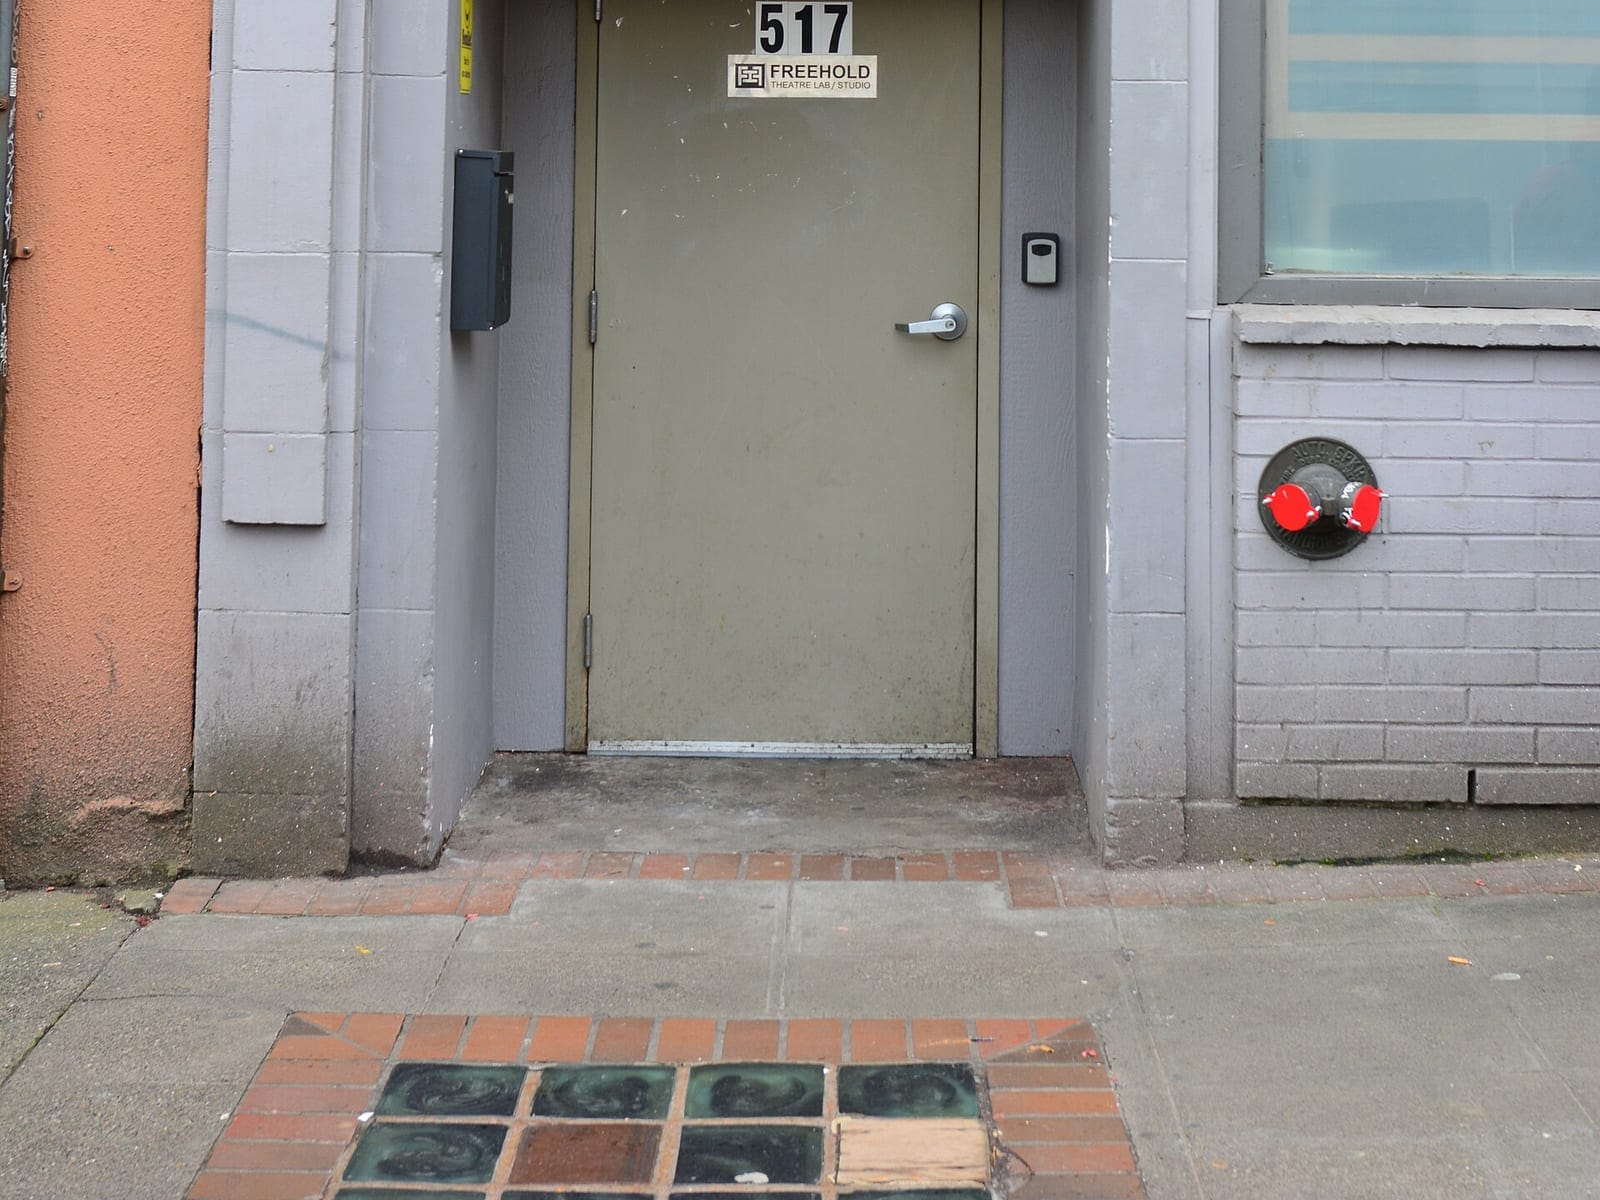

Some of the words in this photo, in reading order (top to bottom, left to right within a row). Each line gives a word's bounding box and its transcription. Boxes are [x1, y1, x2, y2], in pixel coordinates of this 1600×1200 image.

[759, 3, 848, 54] 517
[770, 64, 870, 79] FREEHOLD
[771, 81, 811, 89] THEATRE
[838, 81, 871, 90] STUDIO
